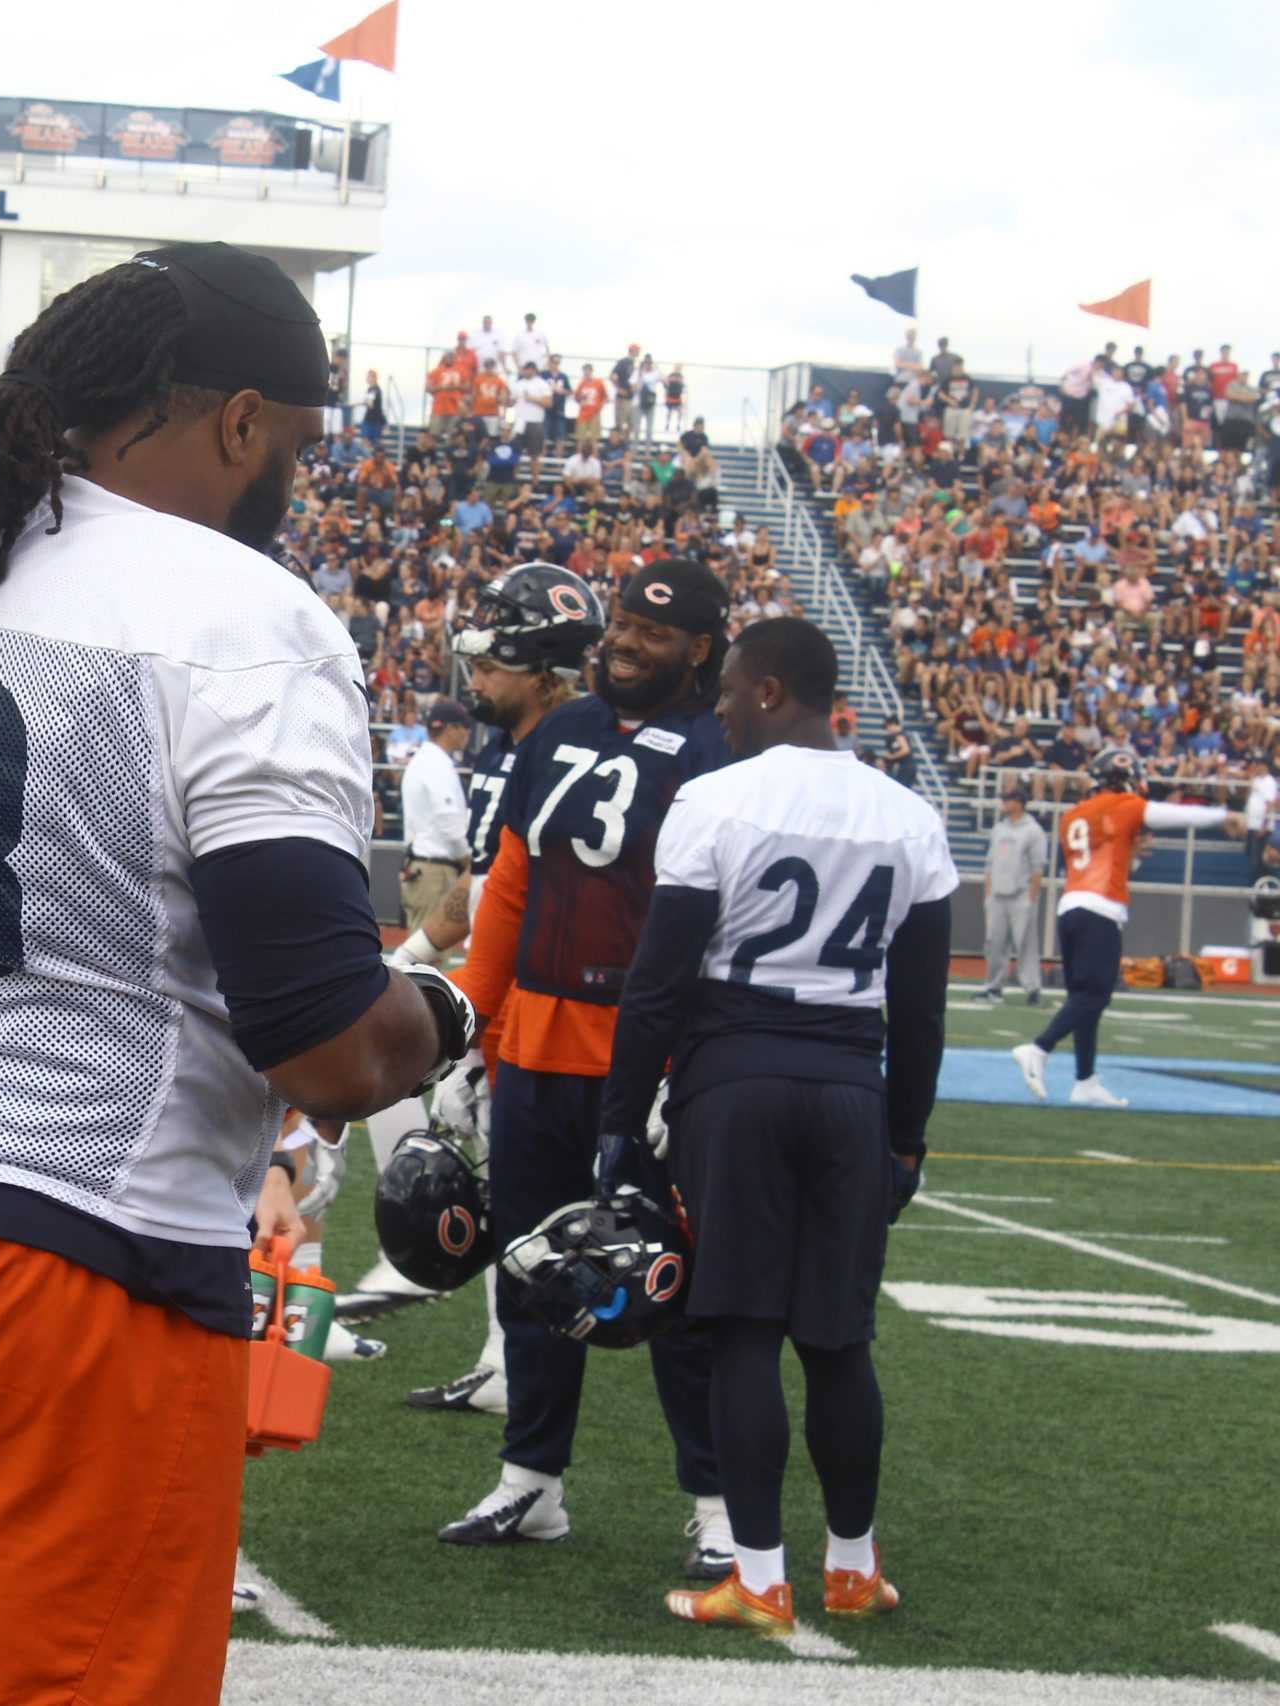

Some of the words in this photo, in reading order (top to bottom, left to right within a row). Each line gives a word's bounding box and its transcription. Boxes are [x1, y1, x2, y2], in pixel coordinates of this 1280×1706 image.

[644, 582, 674, 605] C
[527, 744, 638, 868] 73
[1067, 818, 1091, 870] 9
[727, 856, 894, 1000] 24
